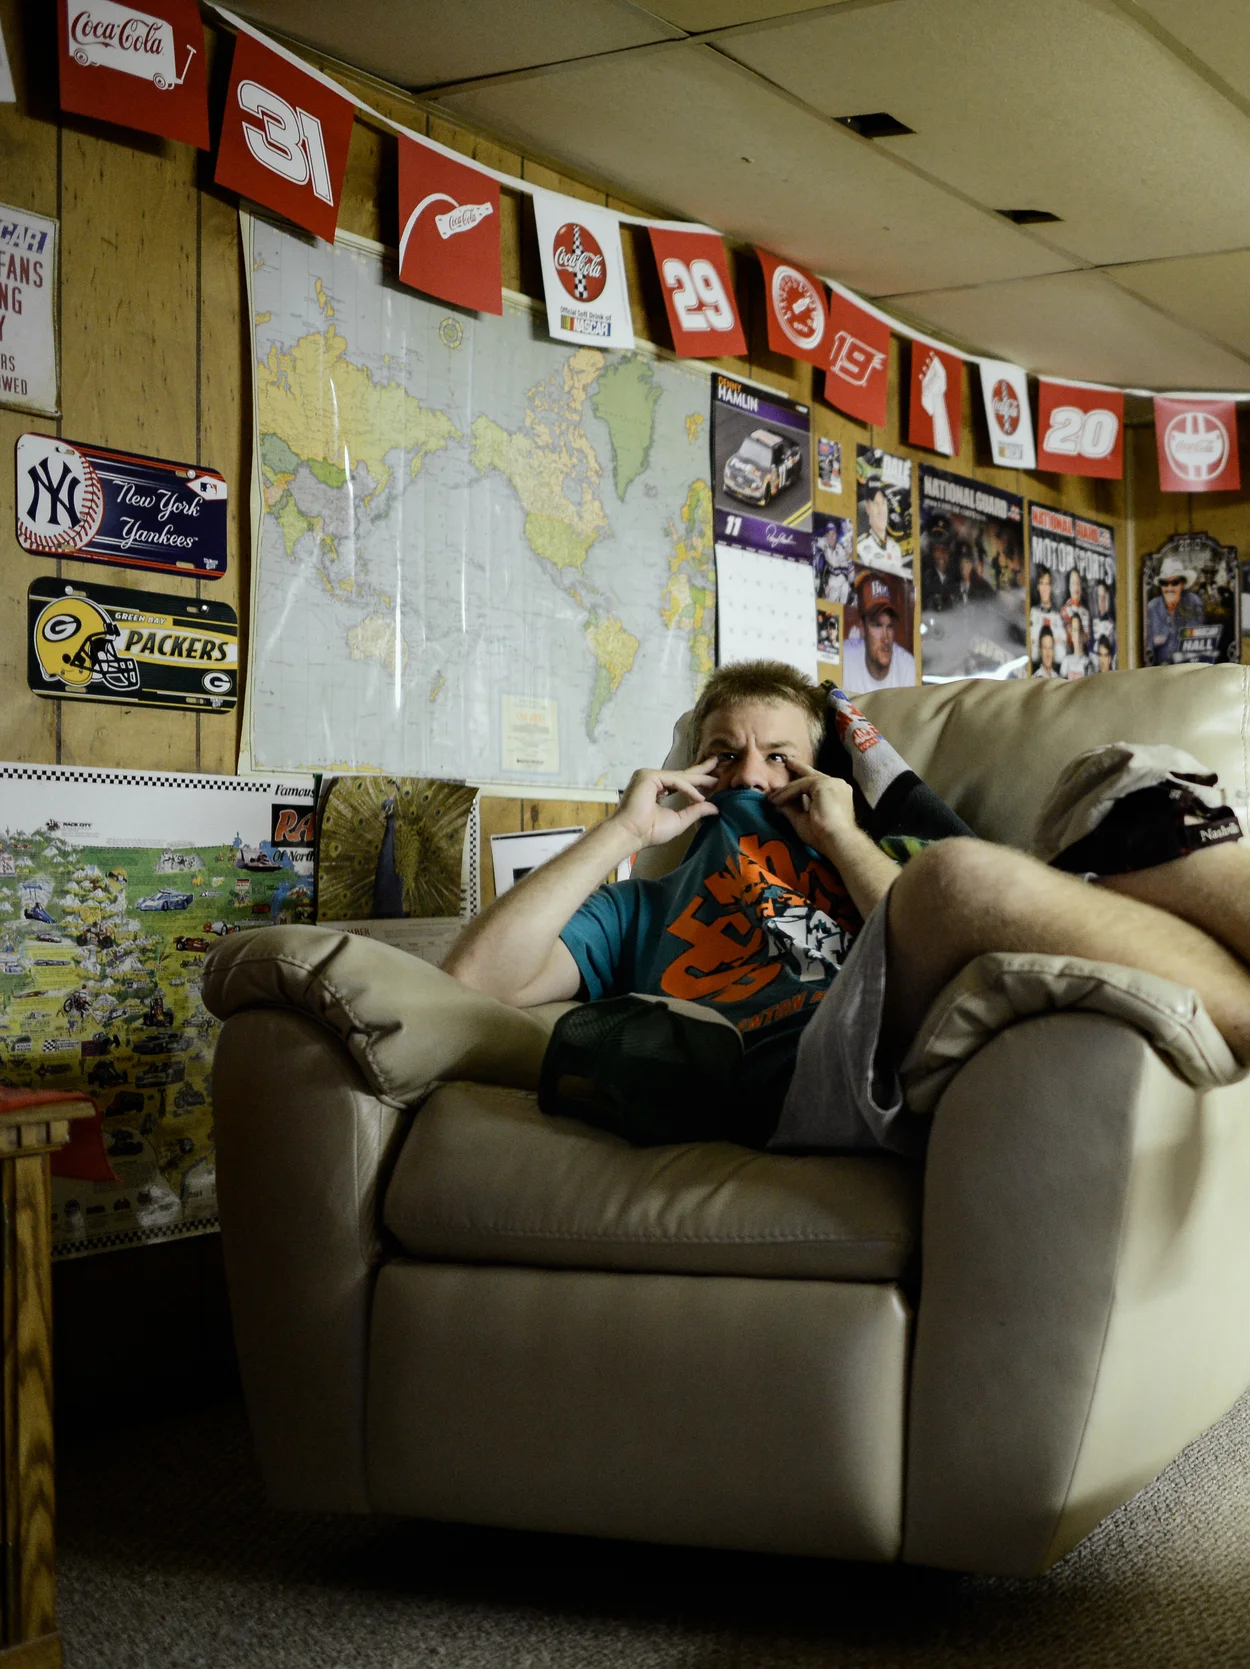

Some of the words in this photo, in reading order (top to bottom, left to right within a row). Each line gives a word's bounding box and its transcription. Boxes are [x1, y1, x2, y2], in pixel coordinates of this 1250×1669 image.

[71, 11, 163, 54] Coca-Cola
[238, 80, 333, 207] 31
[554, 246, 603, 278] Coca-Cola
[662, 258, 735, 332] 29
[830, 331, 887, 385] 19
[717, 383, 758, 412] HAMLIN
[1042, 406, 1119, 459] 20
[113, 480, 156, 509] New
[156, 489, 203, 522] York
[119, 516, 193, 550] Yankees
[724, 515, 743, 536] 11
[114, 612, 146, 622] GREEN
[124, 630, 229, 662] PACKERS
[1182, 638, 1213, 651] HALL
[272, 850, 286, 861] Of
